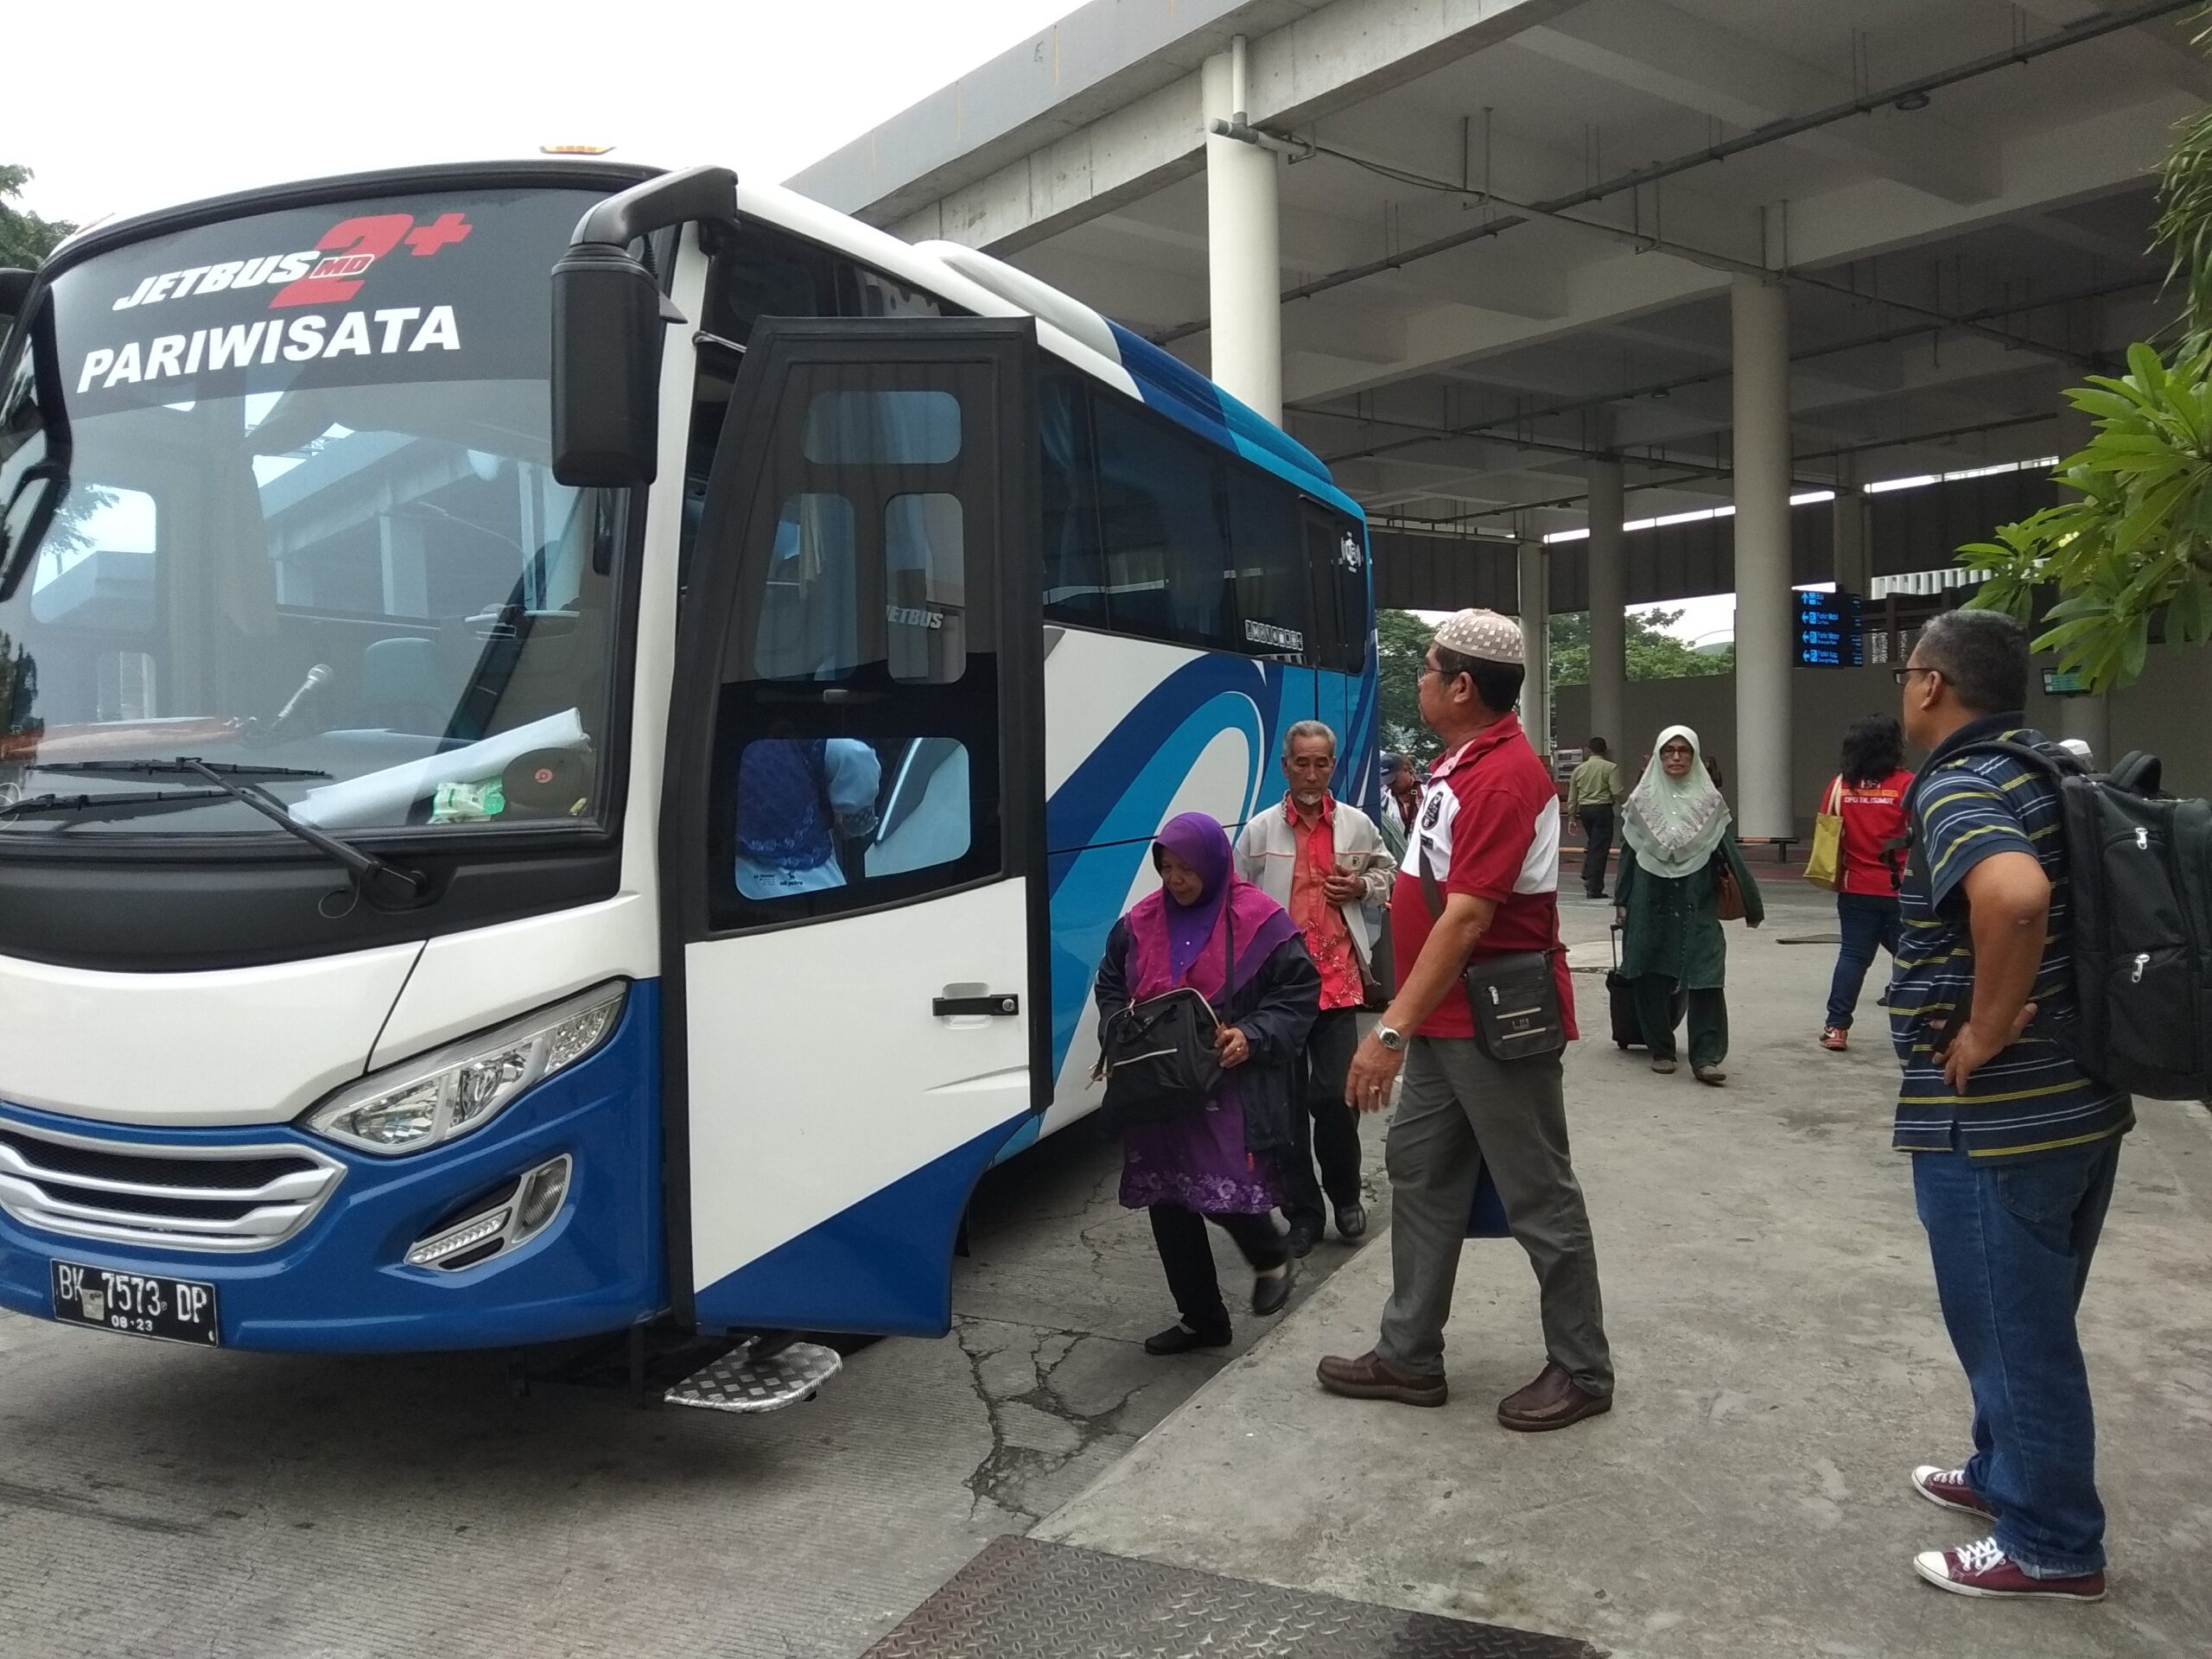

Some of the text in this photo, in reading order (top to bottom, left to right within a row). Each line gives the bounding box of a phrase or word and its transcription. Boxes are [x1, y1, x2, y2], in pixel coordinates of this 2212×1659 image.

[111, 251, 321, 311] JETBUS
[76, 305, 461, 393] PARIWISATA
[59, 1265, 207, 1323] BK 7573 DP
